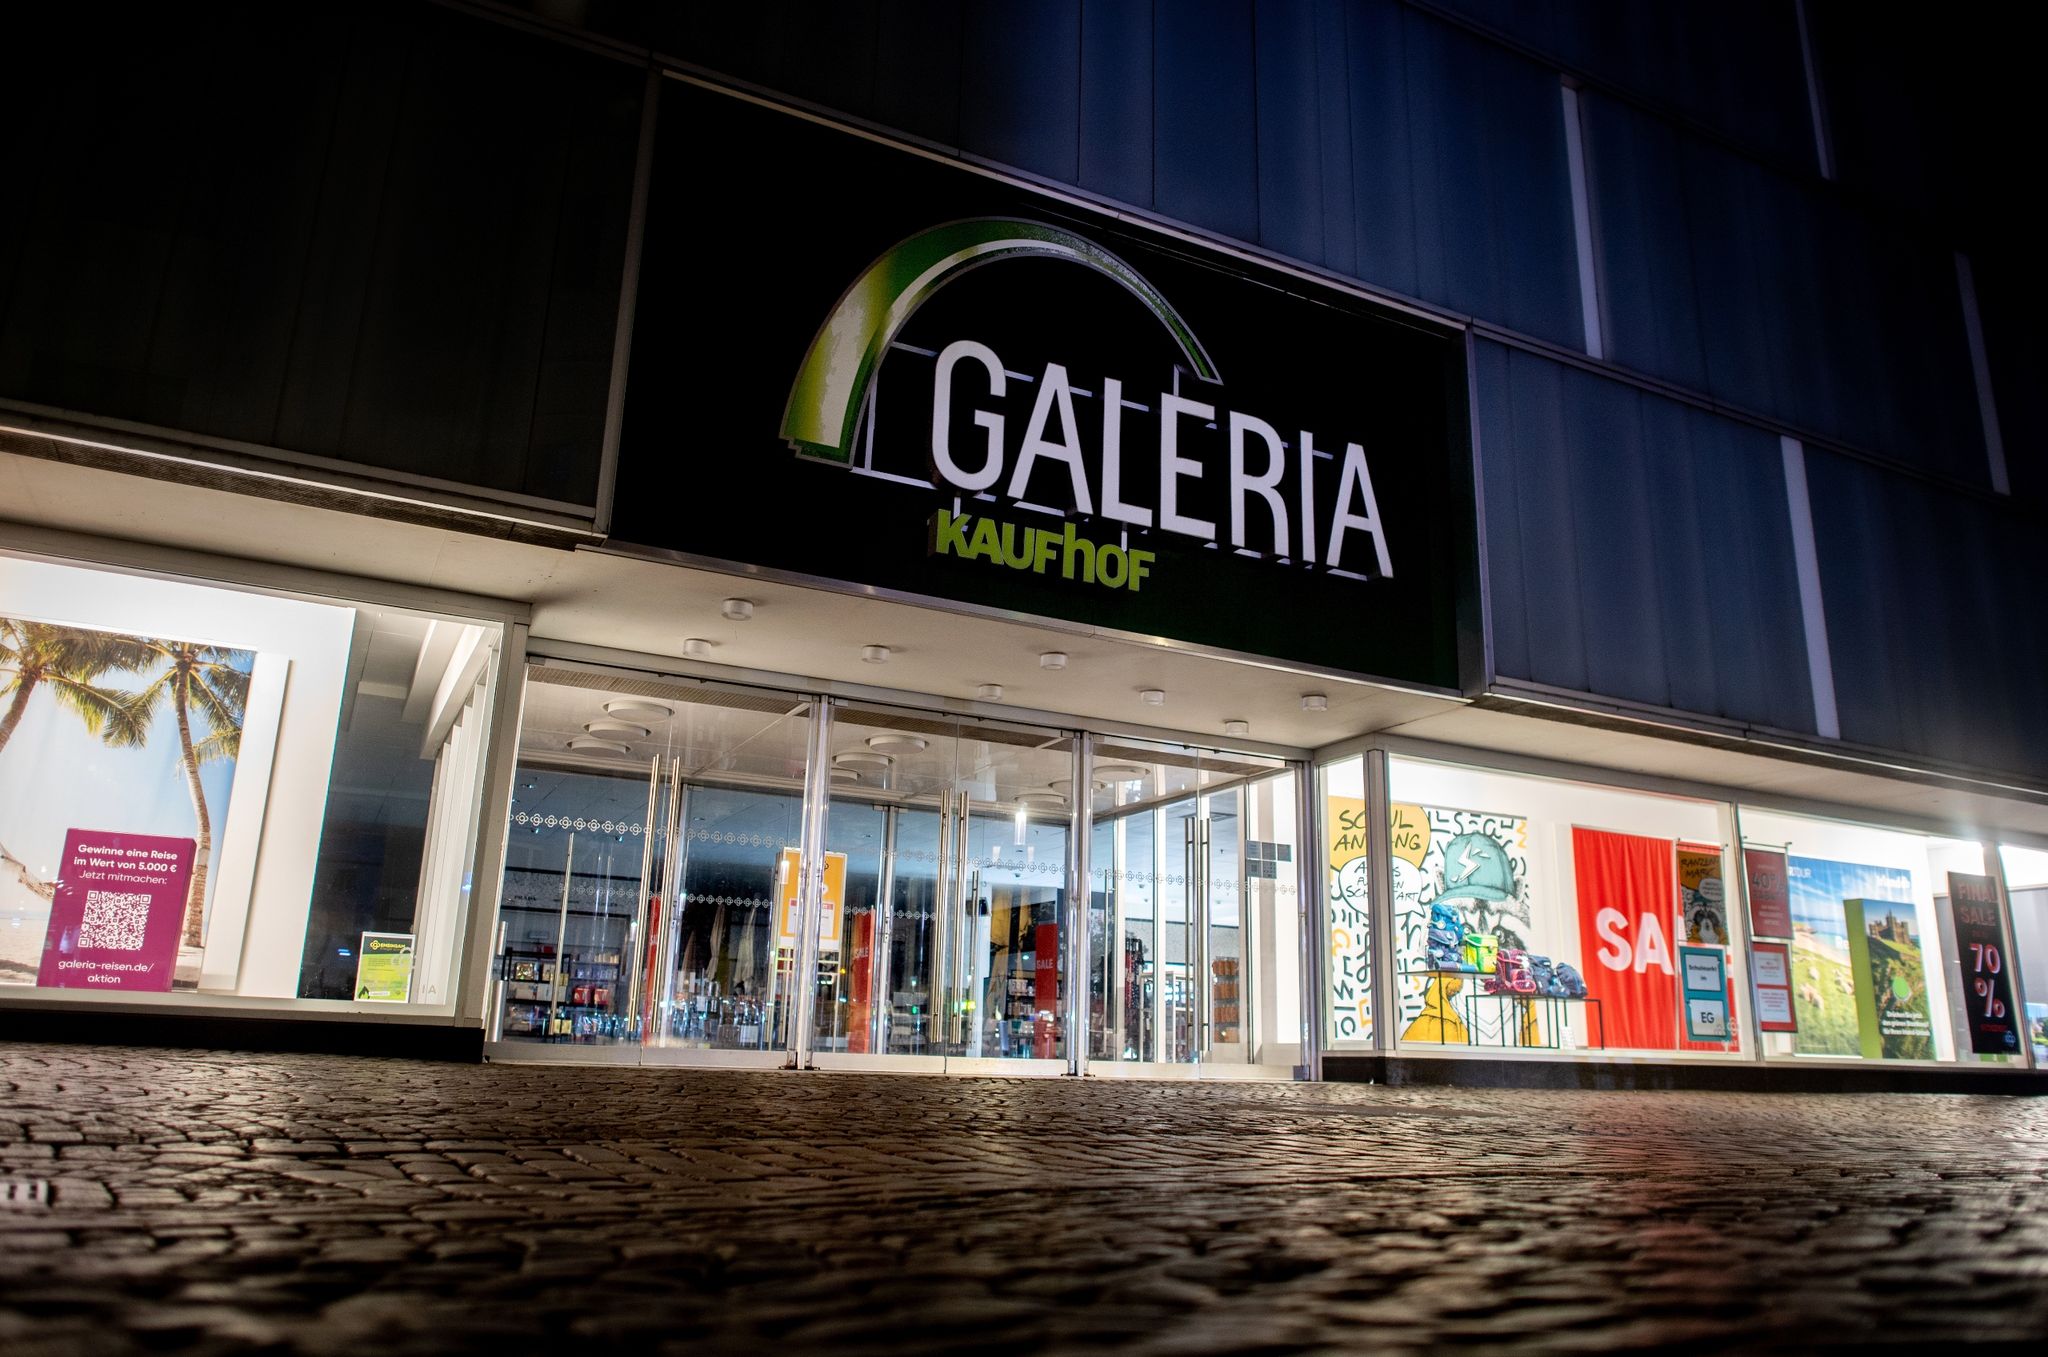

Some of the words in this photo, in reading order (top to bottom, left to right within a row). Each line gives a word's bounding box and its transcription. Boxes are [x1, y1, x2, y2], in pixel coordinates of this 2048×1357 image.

[932, 339, 1394, 579] GALERIA
[1333, 832, 1422, 852] ANNG
[78, 844, 123, 856] Gewinne
[126, 848, 148, 858] eine
[150, 850, 178, 860] Reise
[73, 856, 86, 866] im
[89, 857, 114, 868] Wert
[117, 861, 136, 870] von
[138, 861, 168, 872] 5.000
[169, 864, 177, 873] €
[78, 870, 105, 880] Jetzt
[107, 872, 168, 884] mitmachen:
[1960, 906, 1996, 926] SALE
[58, 959, 154, 973] galeria-reisen.de/
[1036, 958, 1054, 970] SALE
[1970, 942, 2001, 975] 70
[87, 973, 121, 984] aktion
[1974, 976, 2005, 1018] %
[1701, 1011, 1714, 1024] EG
